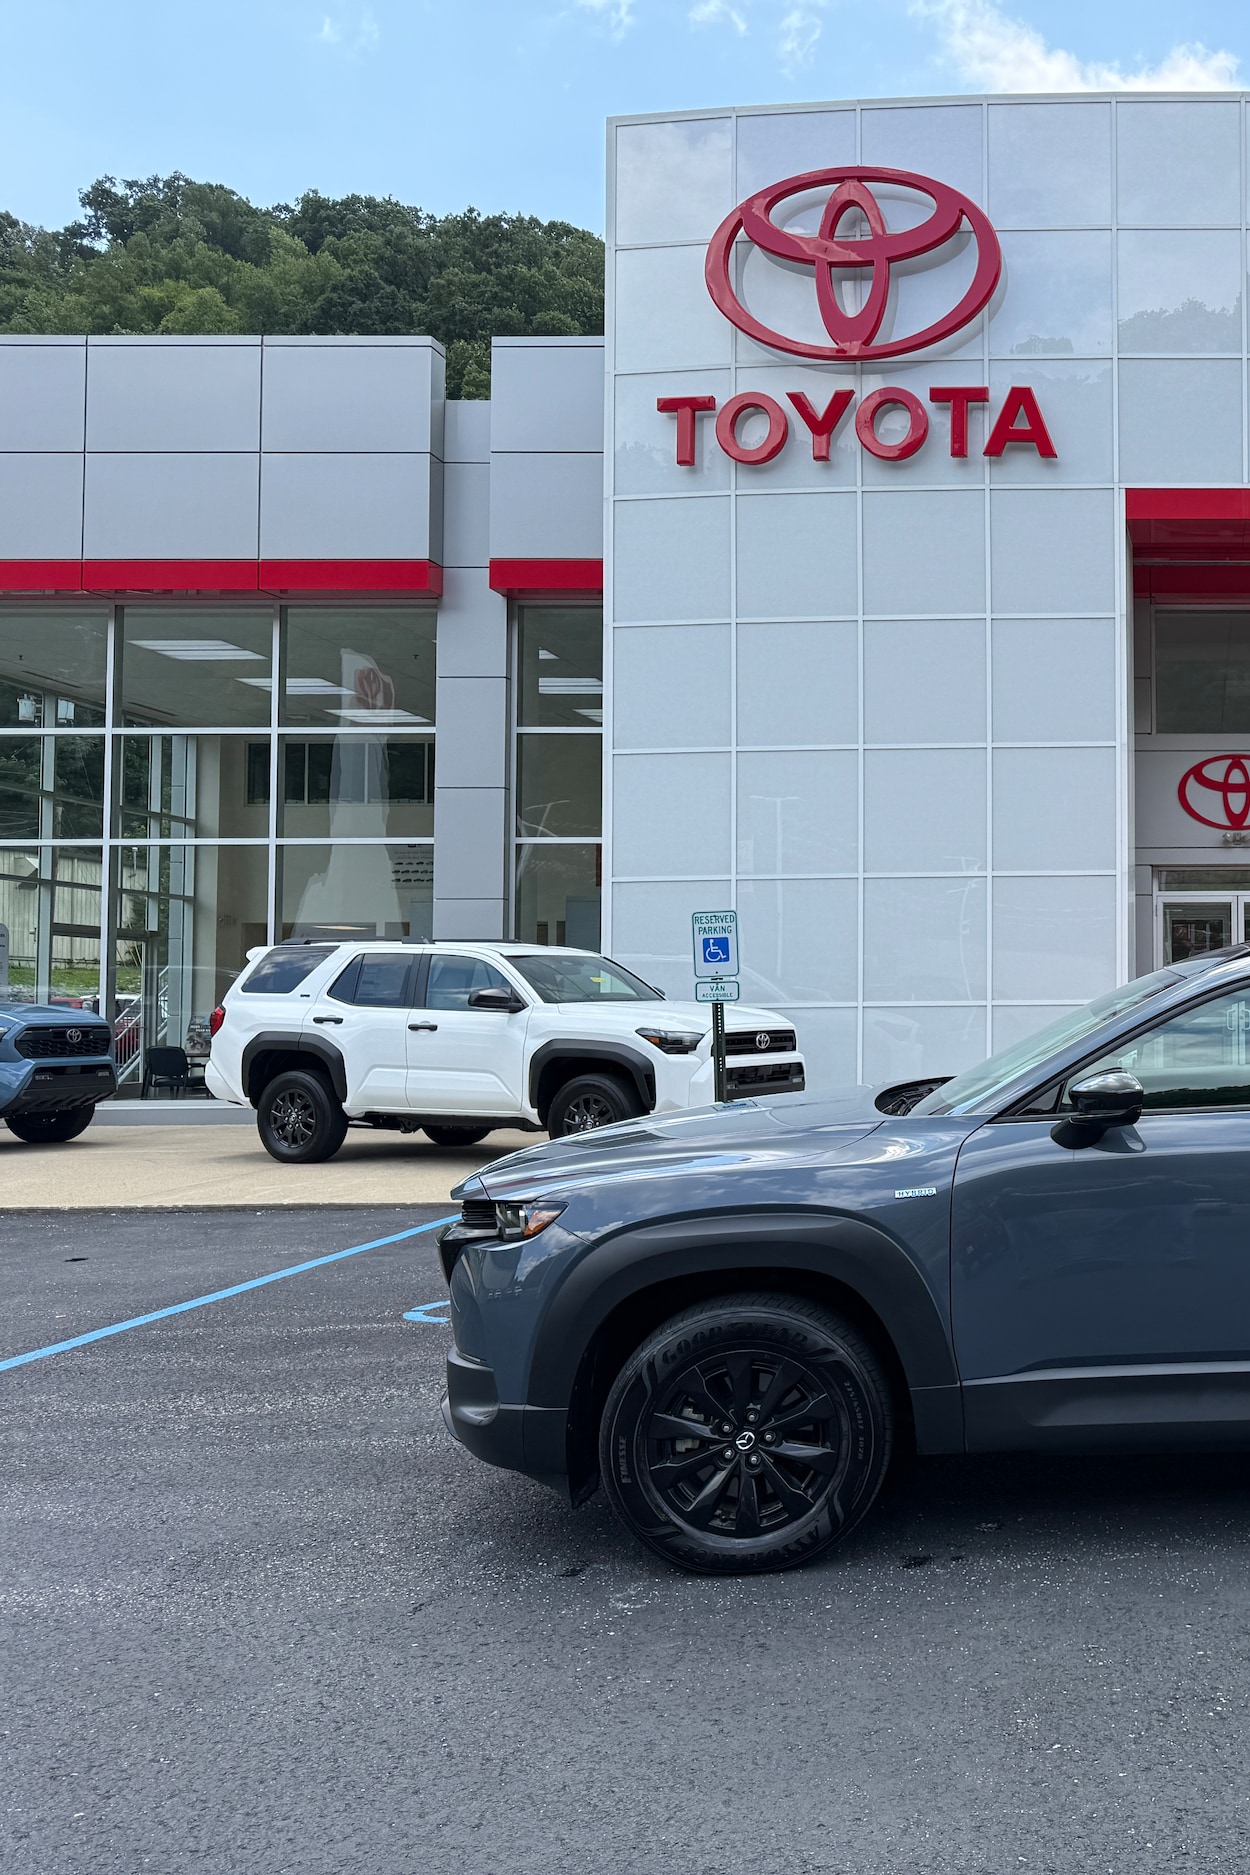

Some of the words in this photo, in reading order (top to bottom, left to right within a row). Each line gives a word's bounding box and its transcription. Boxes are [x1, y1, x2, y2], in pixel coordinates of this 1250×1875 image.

[657, 386, 1058, 466] TOYOTA
[694, 915, 735, 925] RESERVED
[698, 925, 732, 935] PARKING
[898, 1189, 934, 1197] HYBRID
[621, 1435, 633, 1484] FINESSE
